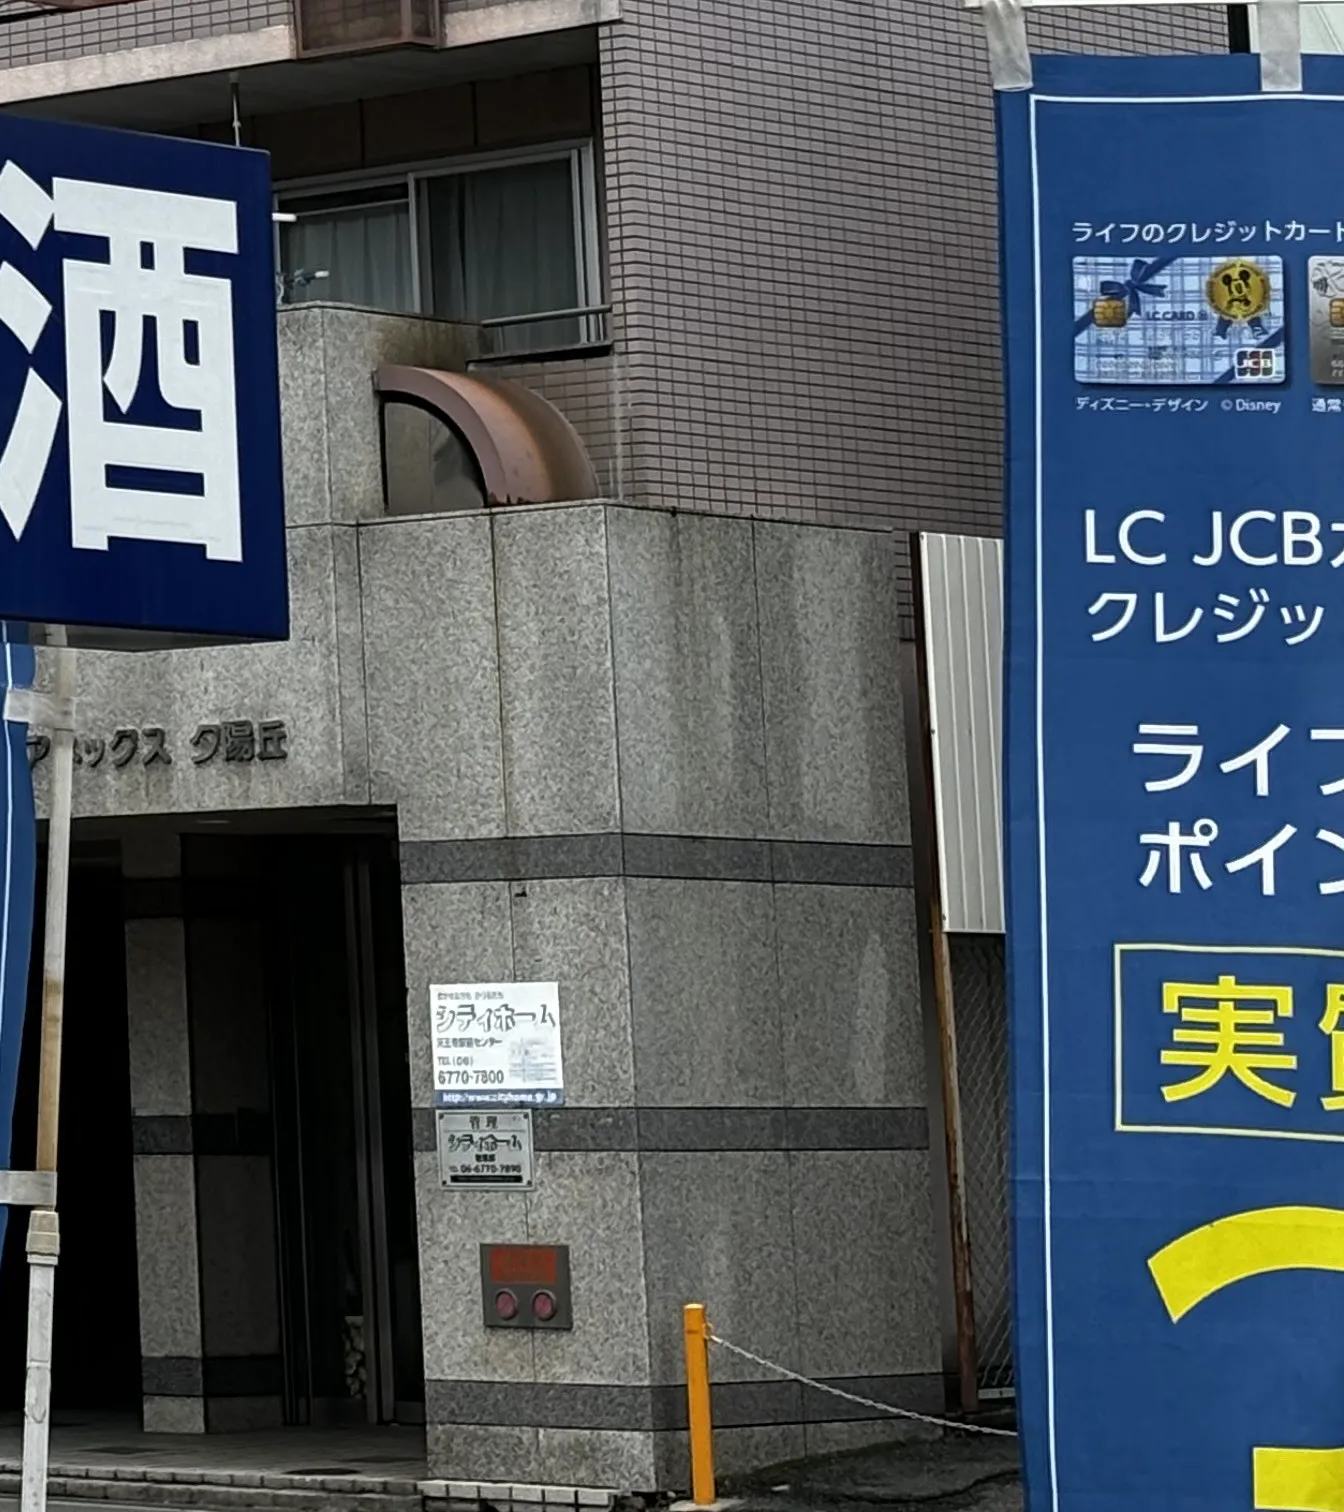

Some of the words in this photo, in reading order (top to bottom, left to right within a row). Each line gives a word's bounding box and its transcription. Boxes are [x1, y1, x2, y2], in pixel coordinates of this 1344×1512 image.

[1235, 397, 1282, 414] Disney
[1312, 397, 1344, 412] 通常
[1085, 509, 1167, 565] LC
[1087, 588, 1325, 645] クレジッ
[189, 719, 288, 767] 夕陽丘
[435, 1003, 556, 1033] シティホーム
[1160, 975, 1344, 1112] 実
[438, 1069, 505, 1085] 6770-7800
